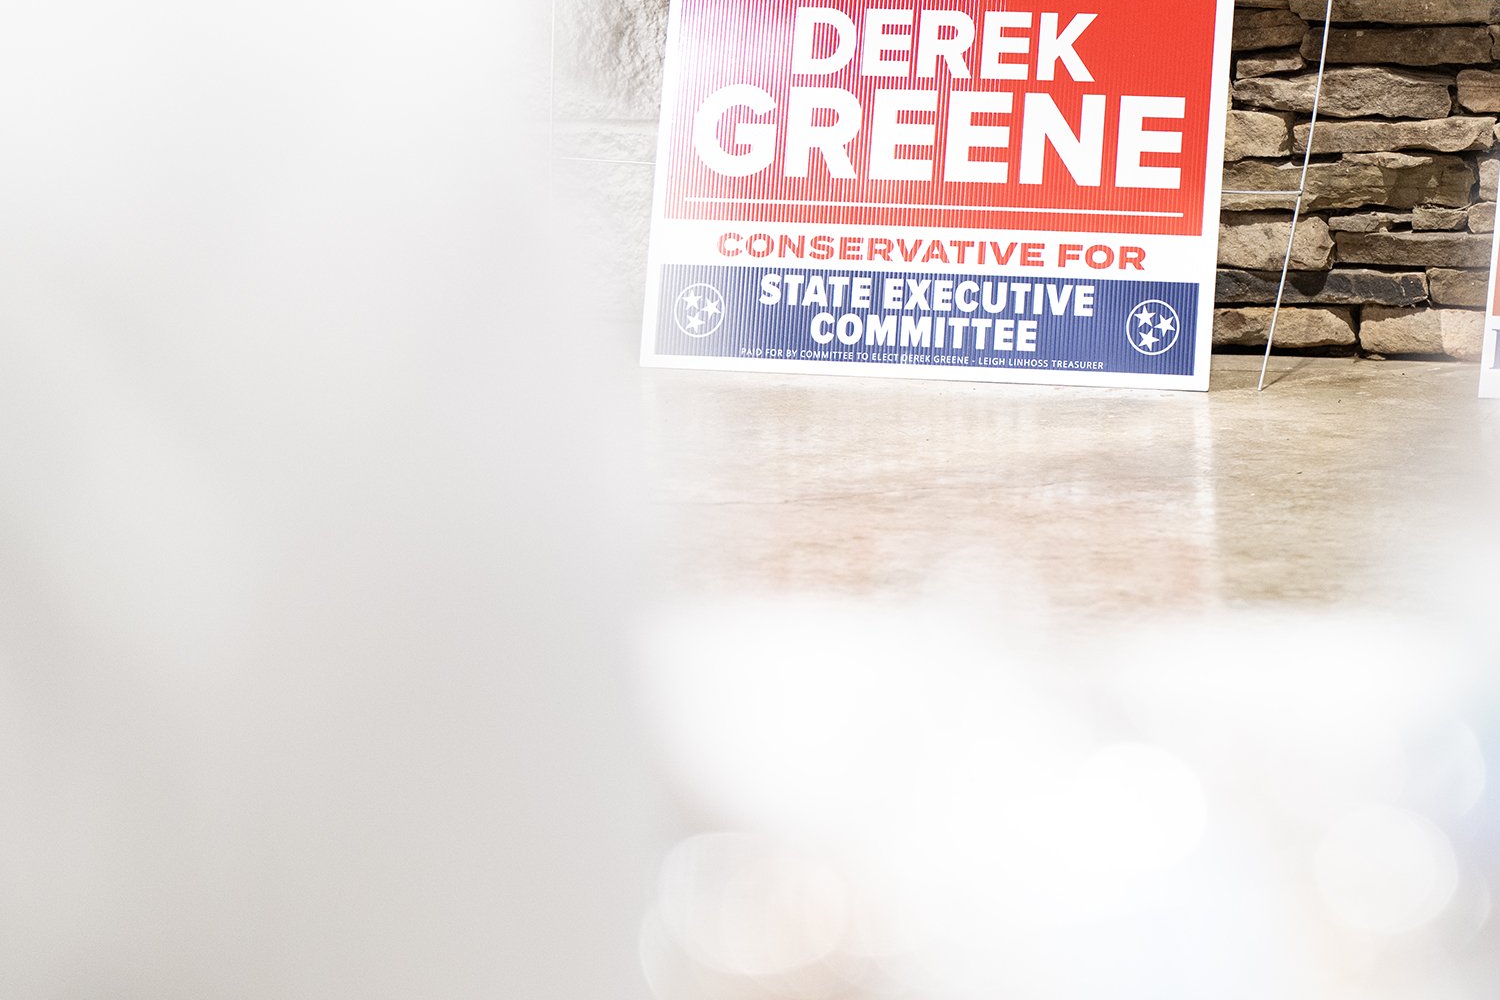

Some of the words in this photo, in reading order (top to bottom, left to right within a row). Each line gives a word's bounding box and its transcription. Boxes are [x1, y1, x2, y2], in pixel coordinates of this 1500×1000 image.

[791, 6, 1098, 82] DEREK
[693, 83, 1187, 190] GREENE
[716, 232, 1047, 267] CONSERVATIVE
[1057, 243, 1146, 271] FOR
[759, 274, 873, 310] STATE
[883, 279, 1095, 317] EXECUTIVE
[809, 312, 1038, 352] COMMITTEE
[741, 347, 762, 356] PAID
[765, 348, 783, 357] FOR
[786, 349, 797, 358] BY
[800, 350, 853, 360] COMMITTEE
[856, 352, 869, 360] TO
[872, 352, 899, 361] ELECT
[901, 353, 931, 363] DEREK
[933, 355, 969, 364] GREENE
[978, 357, 1005, 366] LEIGH
[1008, 358, 1048, 367] LINHOSS
[1051, 360, 1104, 370] TREASURER
